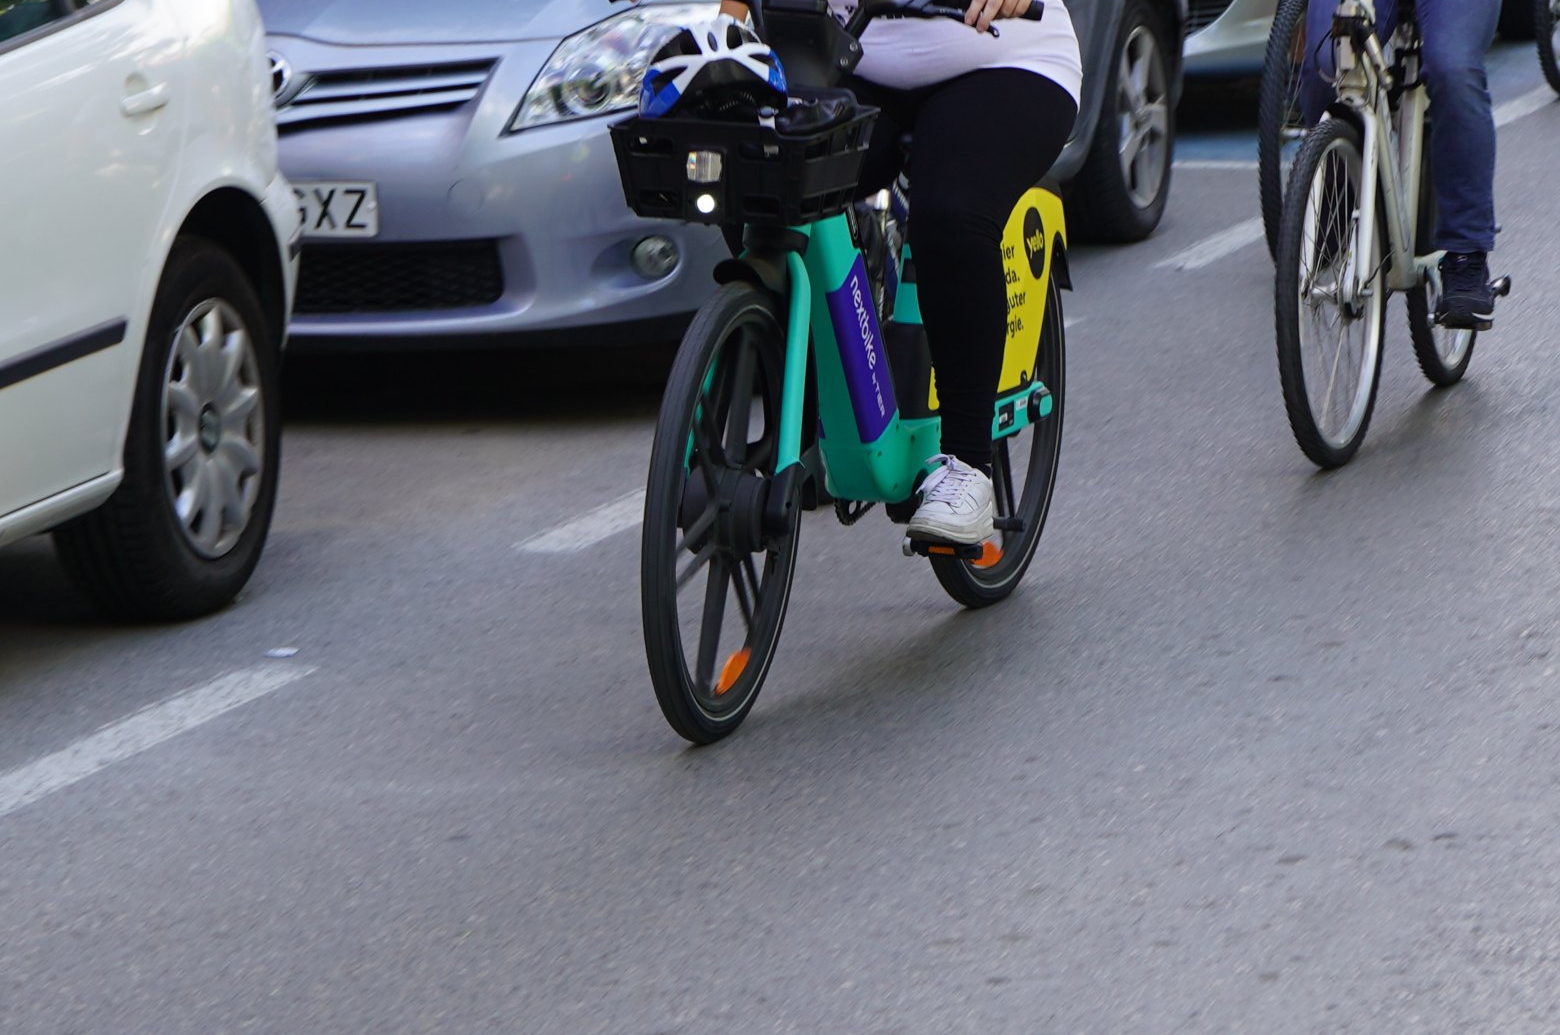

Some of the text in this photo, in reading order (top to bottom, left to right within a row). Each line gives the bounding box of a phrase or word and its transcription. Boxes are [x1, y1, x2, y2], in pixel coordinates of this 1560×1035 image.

[1002, 244, 1015, 260] ier
[1026, 228, 1044, 259] yello
[850, 274, 876, 370] nextbike
[874, 380, 886, 419] TIER
